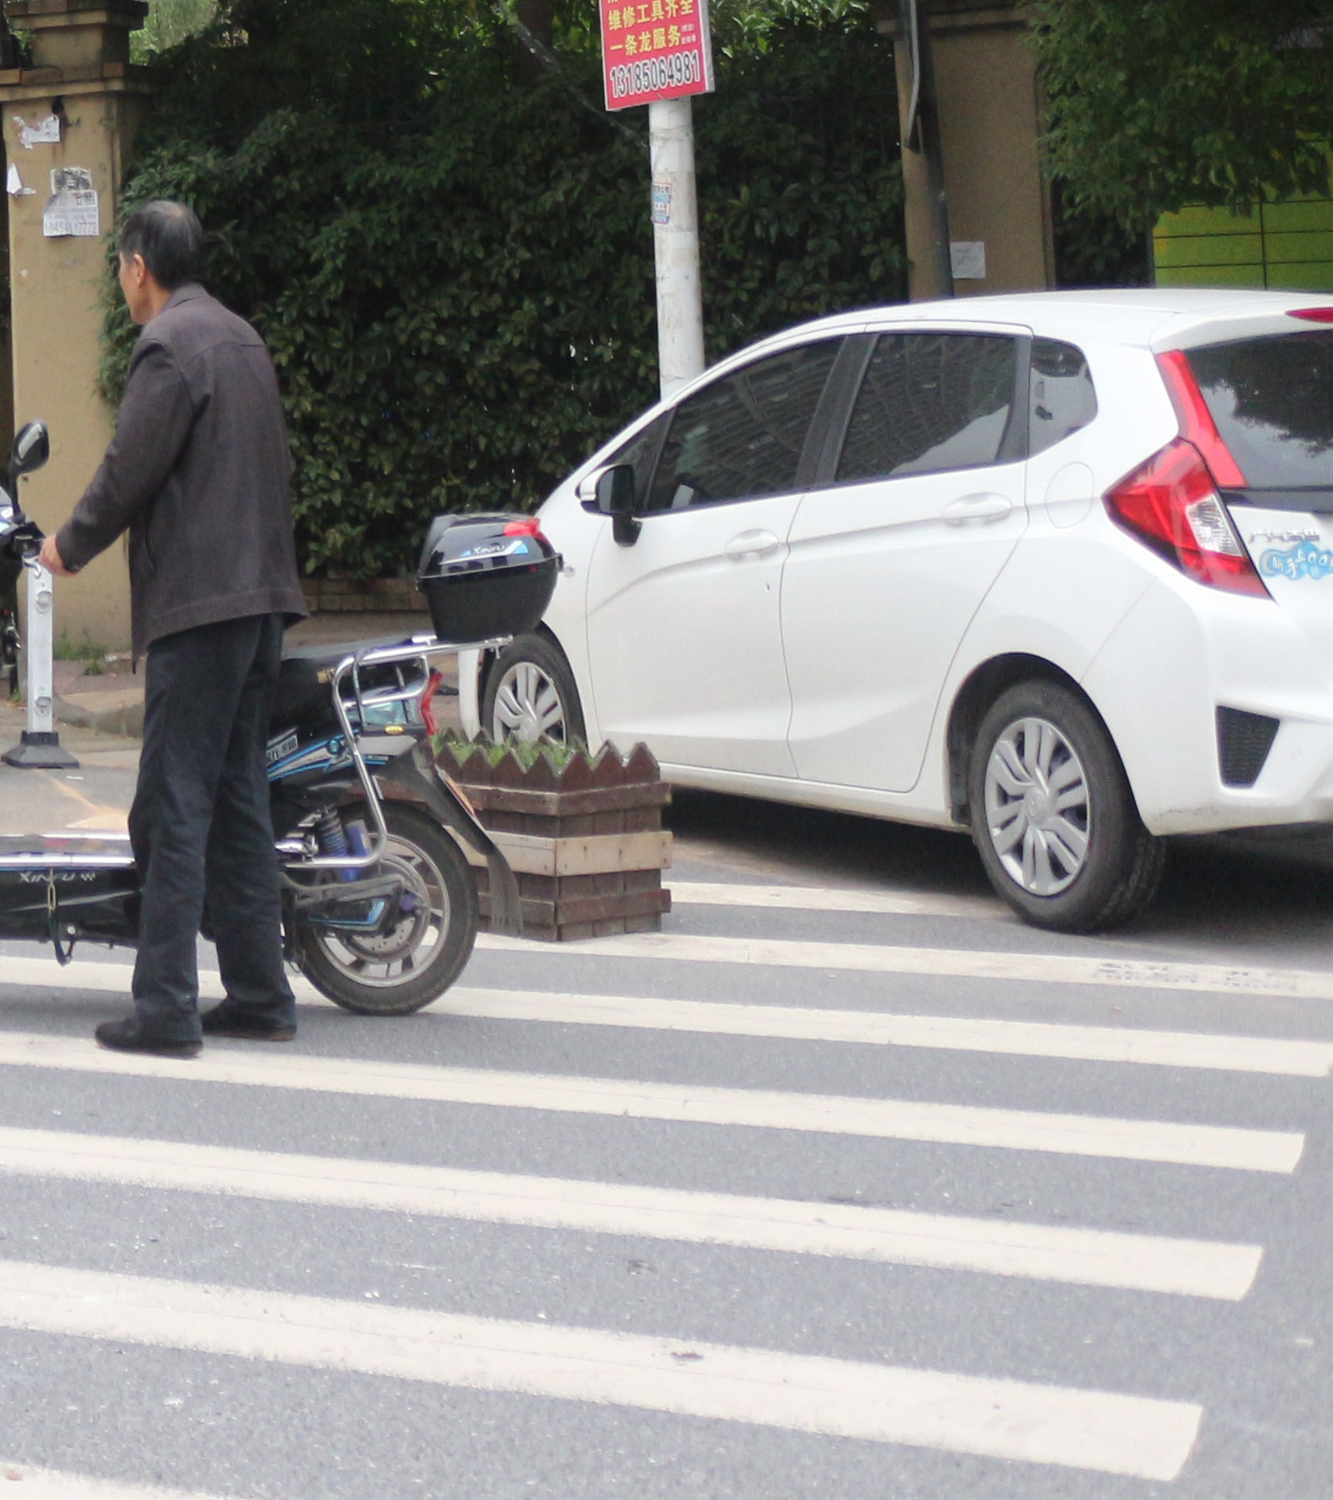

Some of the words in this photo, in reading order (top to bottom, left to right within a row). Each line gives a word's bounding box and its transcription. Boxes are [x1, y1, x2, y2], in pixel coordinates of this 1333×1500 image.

[610, 25, 681, 56] 一条龙服务
[610, 50, 701, 98] 13185064981
